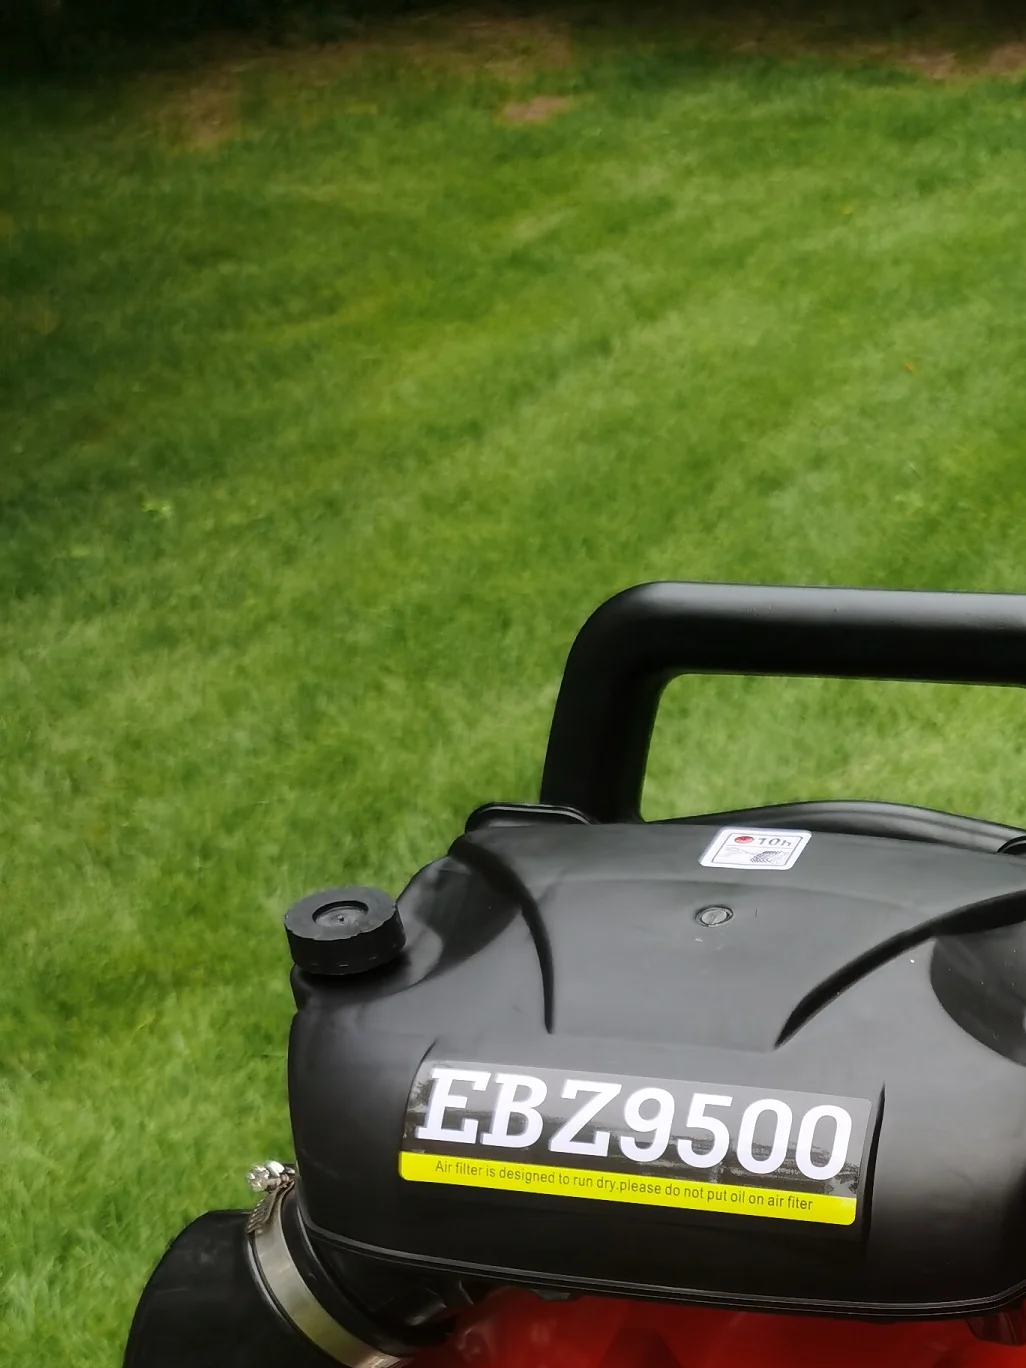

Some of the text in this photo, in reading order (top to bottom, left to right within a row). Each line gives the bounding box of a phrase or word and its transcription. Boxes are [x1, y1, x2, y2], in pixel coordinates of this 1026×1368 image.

[415, 1066, 852, 1180] EBZ9500
[435, 1160, 452, 1173] Air
[455, 1162, 483, 1177] filter
[486, 1165, 496, 1178] is
[499, 1167, 555, 1185] designed
[558, 1173, 570, 1185] to
[573, 1175, 593, 1187] run
[665, 1183, 680, 1196] do
[684, 1186, 704, 1199] not
[707, 1189, 727, 1202] put
[730, 1191, 746, 1204] oil
[749, 1194, 764, 1206] on
[768, 1195, 784, 1207] air
[787, 1196, 813, 1210] fiter
